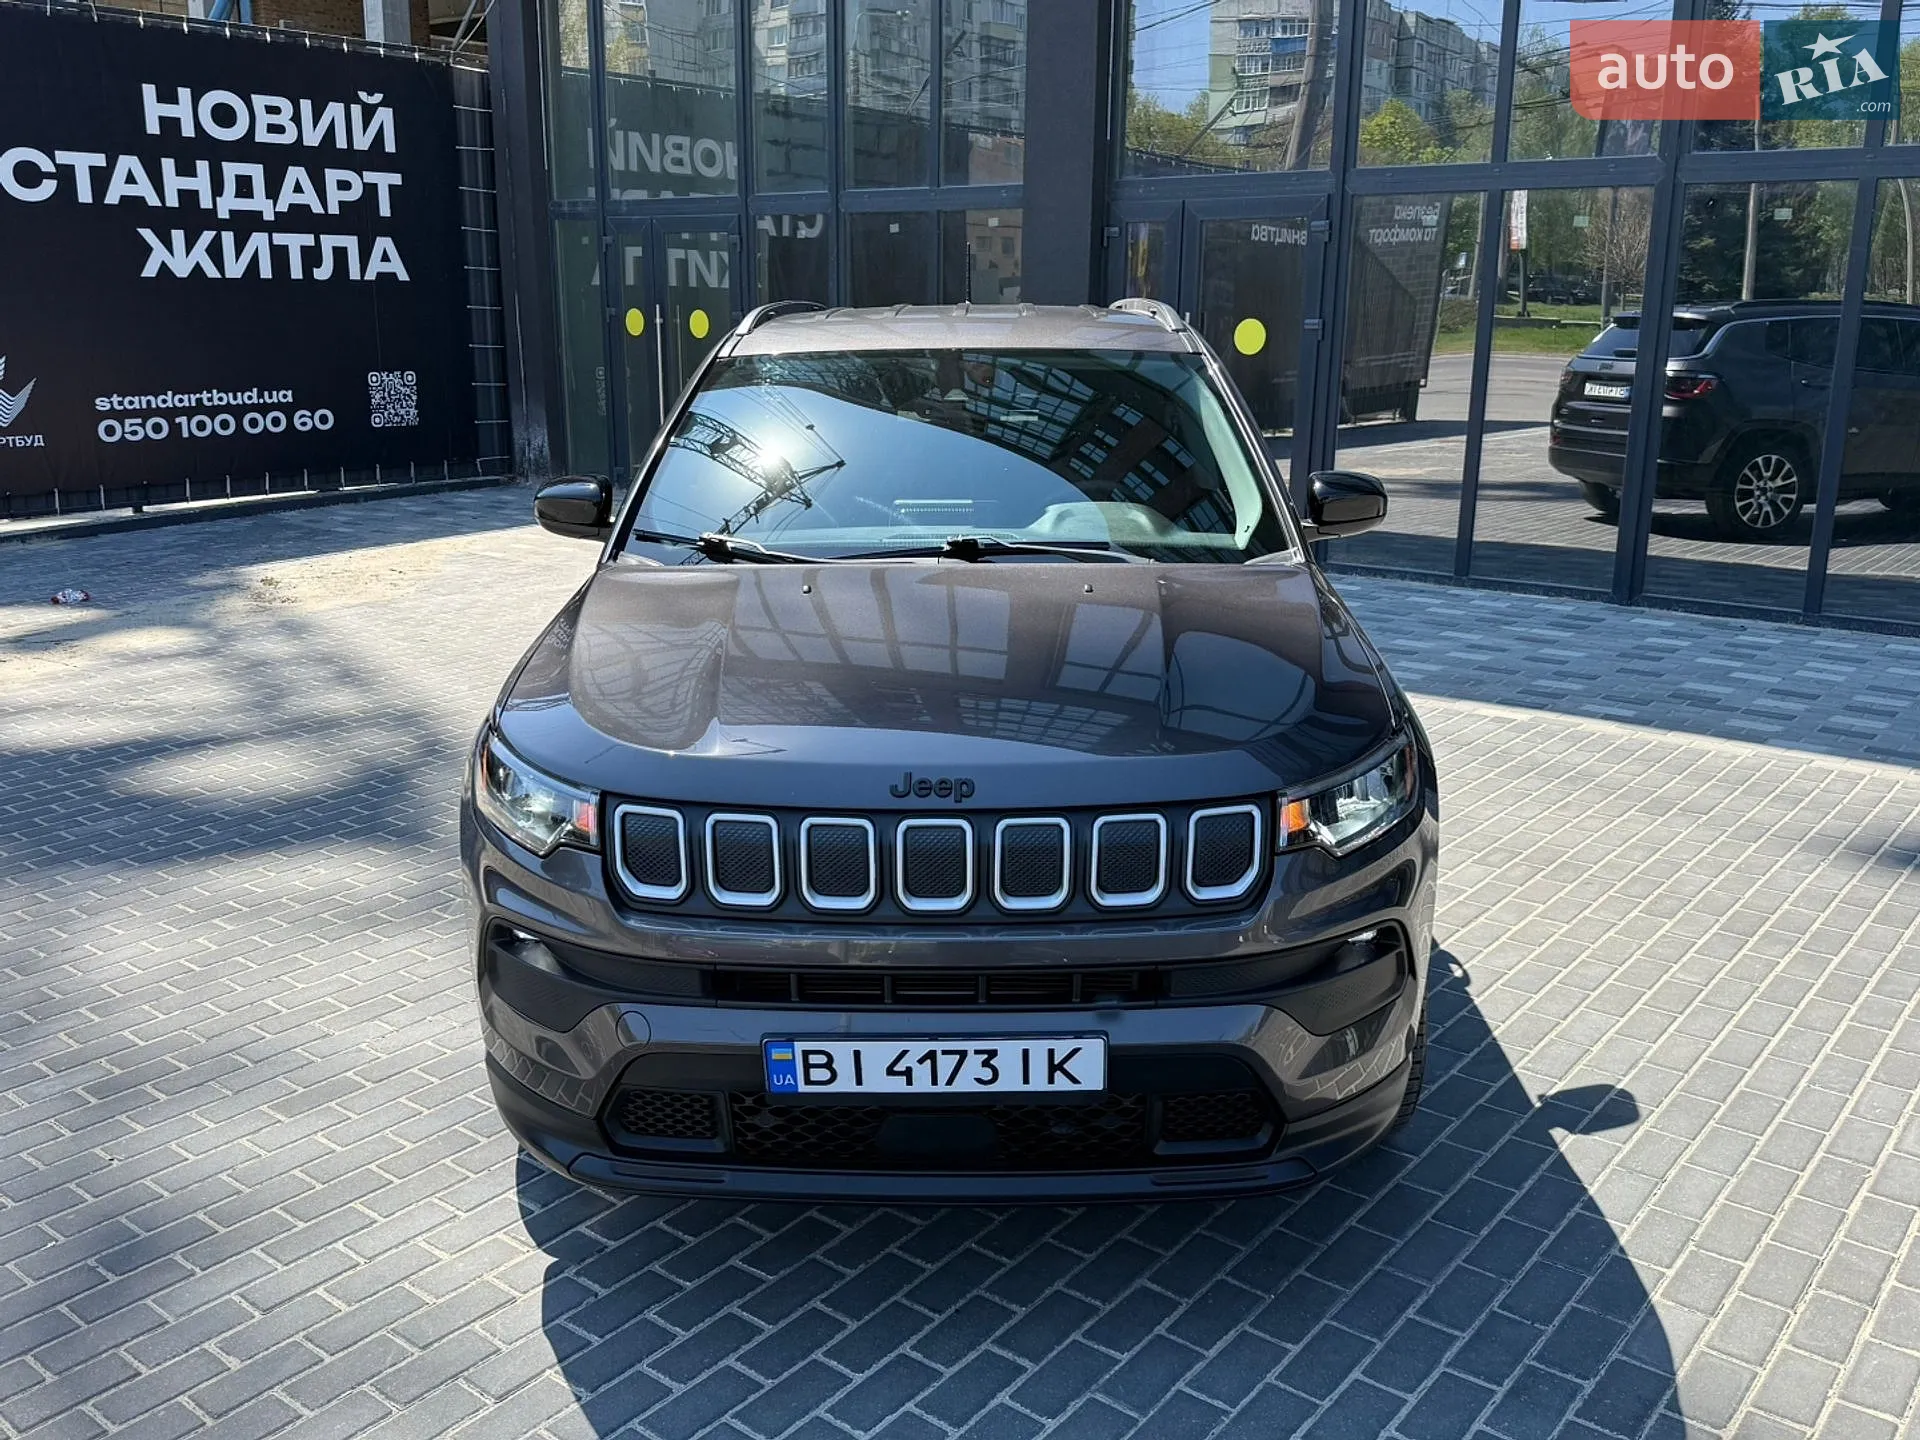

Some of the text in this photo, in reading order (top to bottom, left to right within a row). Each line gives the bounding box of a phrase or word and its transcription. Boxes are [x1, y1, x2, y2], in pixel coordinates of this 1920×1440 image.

[141, 83, 396, 153] НОВИЙ
[0, 147, 402, 221] СТАНДАРТ
[136, 228, 410, 281] ЖИТЛА
[95, 387, 293, 411] standartbud.ua
[97, 408, 335, 443] 050 100 00 60
[889, 771, 975, 803] Jeep
[774, 1074, 796, 1086] UA
[801, 1047, 1083, 1087] BI 4173 IK
